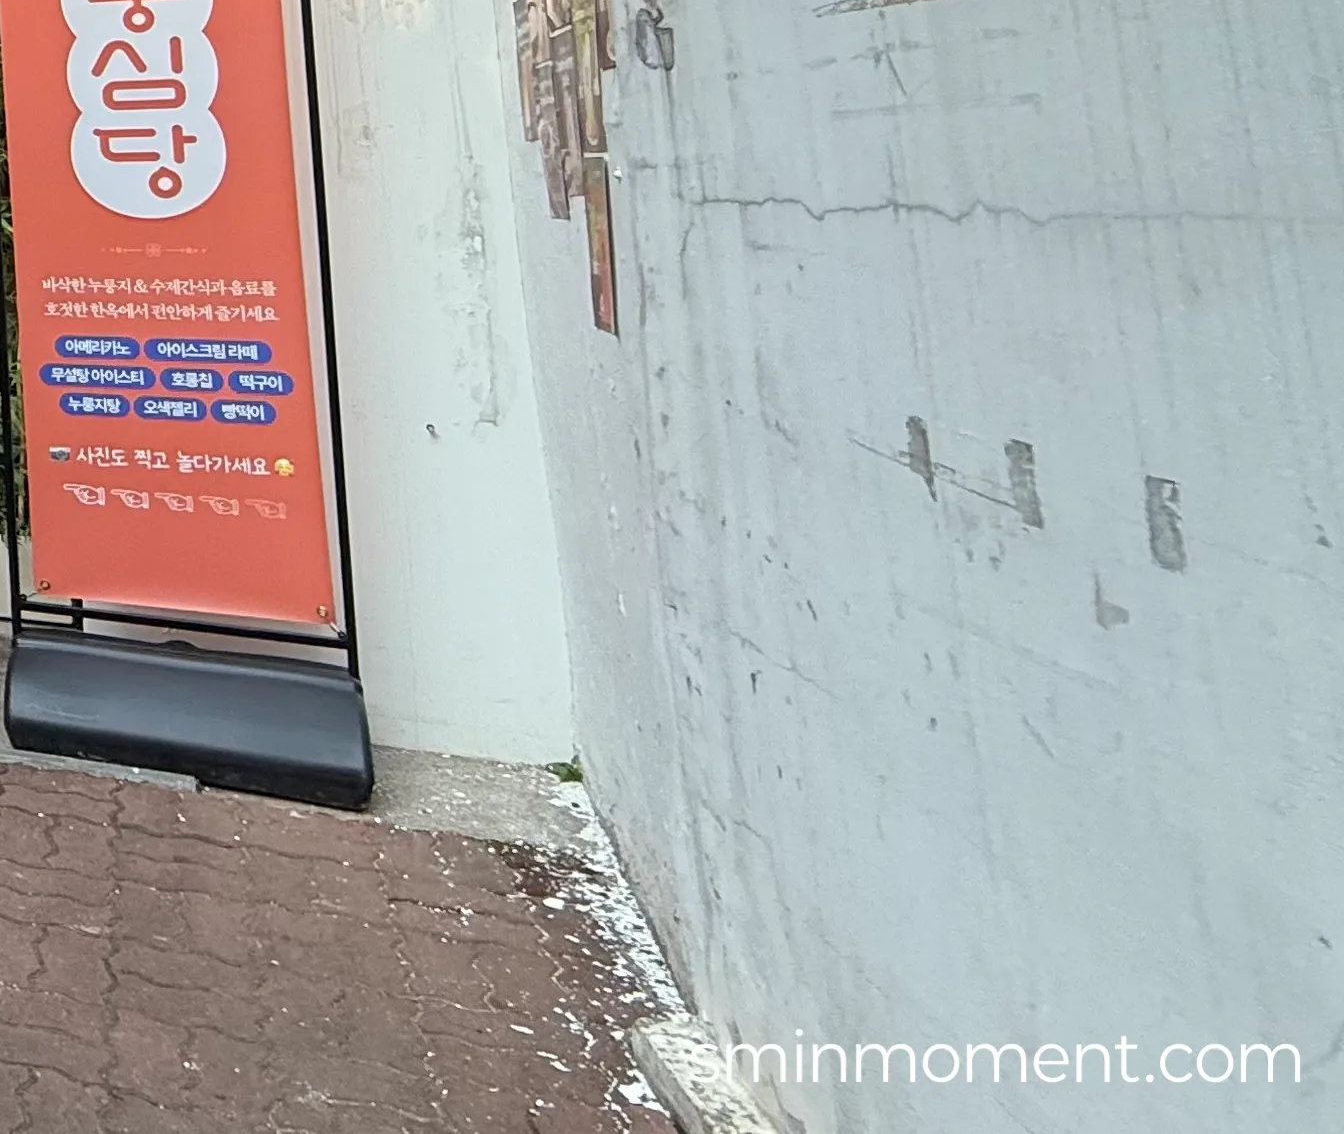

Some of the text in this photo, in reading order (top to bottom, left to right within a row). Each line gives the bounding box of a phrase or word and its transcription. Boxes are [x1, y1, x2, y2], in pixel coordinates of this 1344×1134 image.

[41, 276, 86, 293] 바삭한
[133, 280, 149, 294] &
[149, 279, 227, 296] 수제간식과
[229, 279, 278, 298] 음료를
[90, 302, 150, 320] 한옥에서
[151, 303, 214, 322] 편안하게
[215, 304, 280, 323] 즐기세요
[64, 339, 132, 356] 아메리카노
[156, 341, 259, 361] 아이스크림 라떼
[92, 368, 144, 386] 아이스티
[238, 373, 283, 392] 떡구이
[76, 446, 271, 477] 사진도 찍고 놀다가세요
